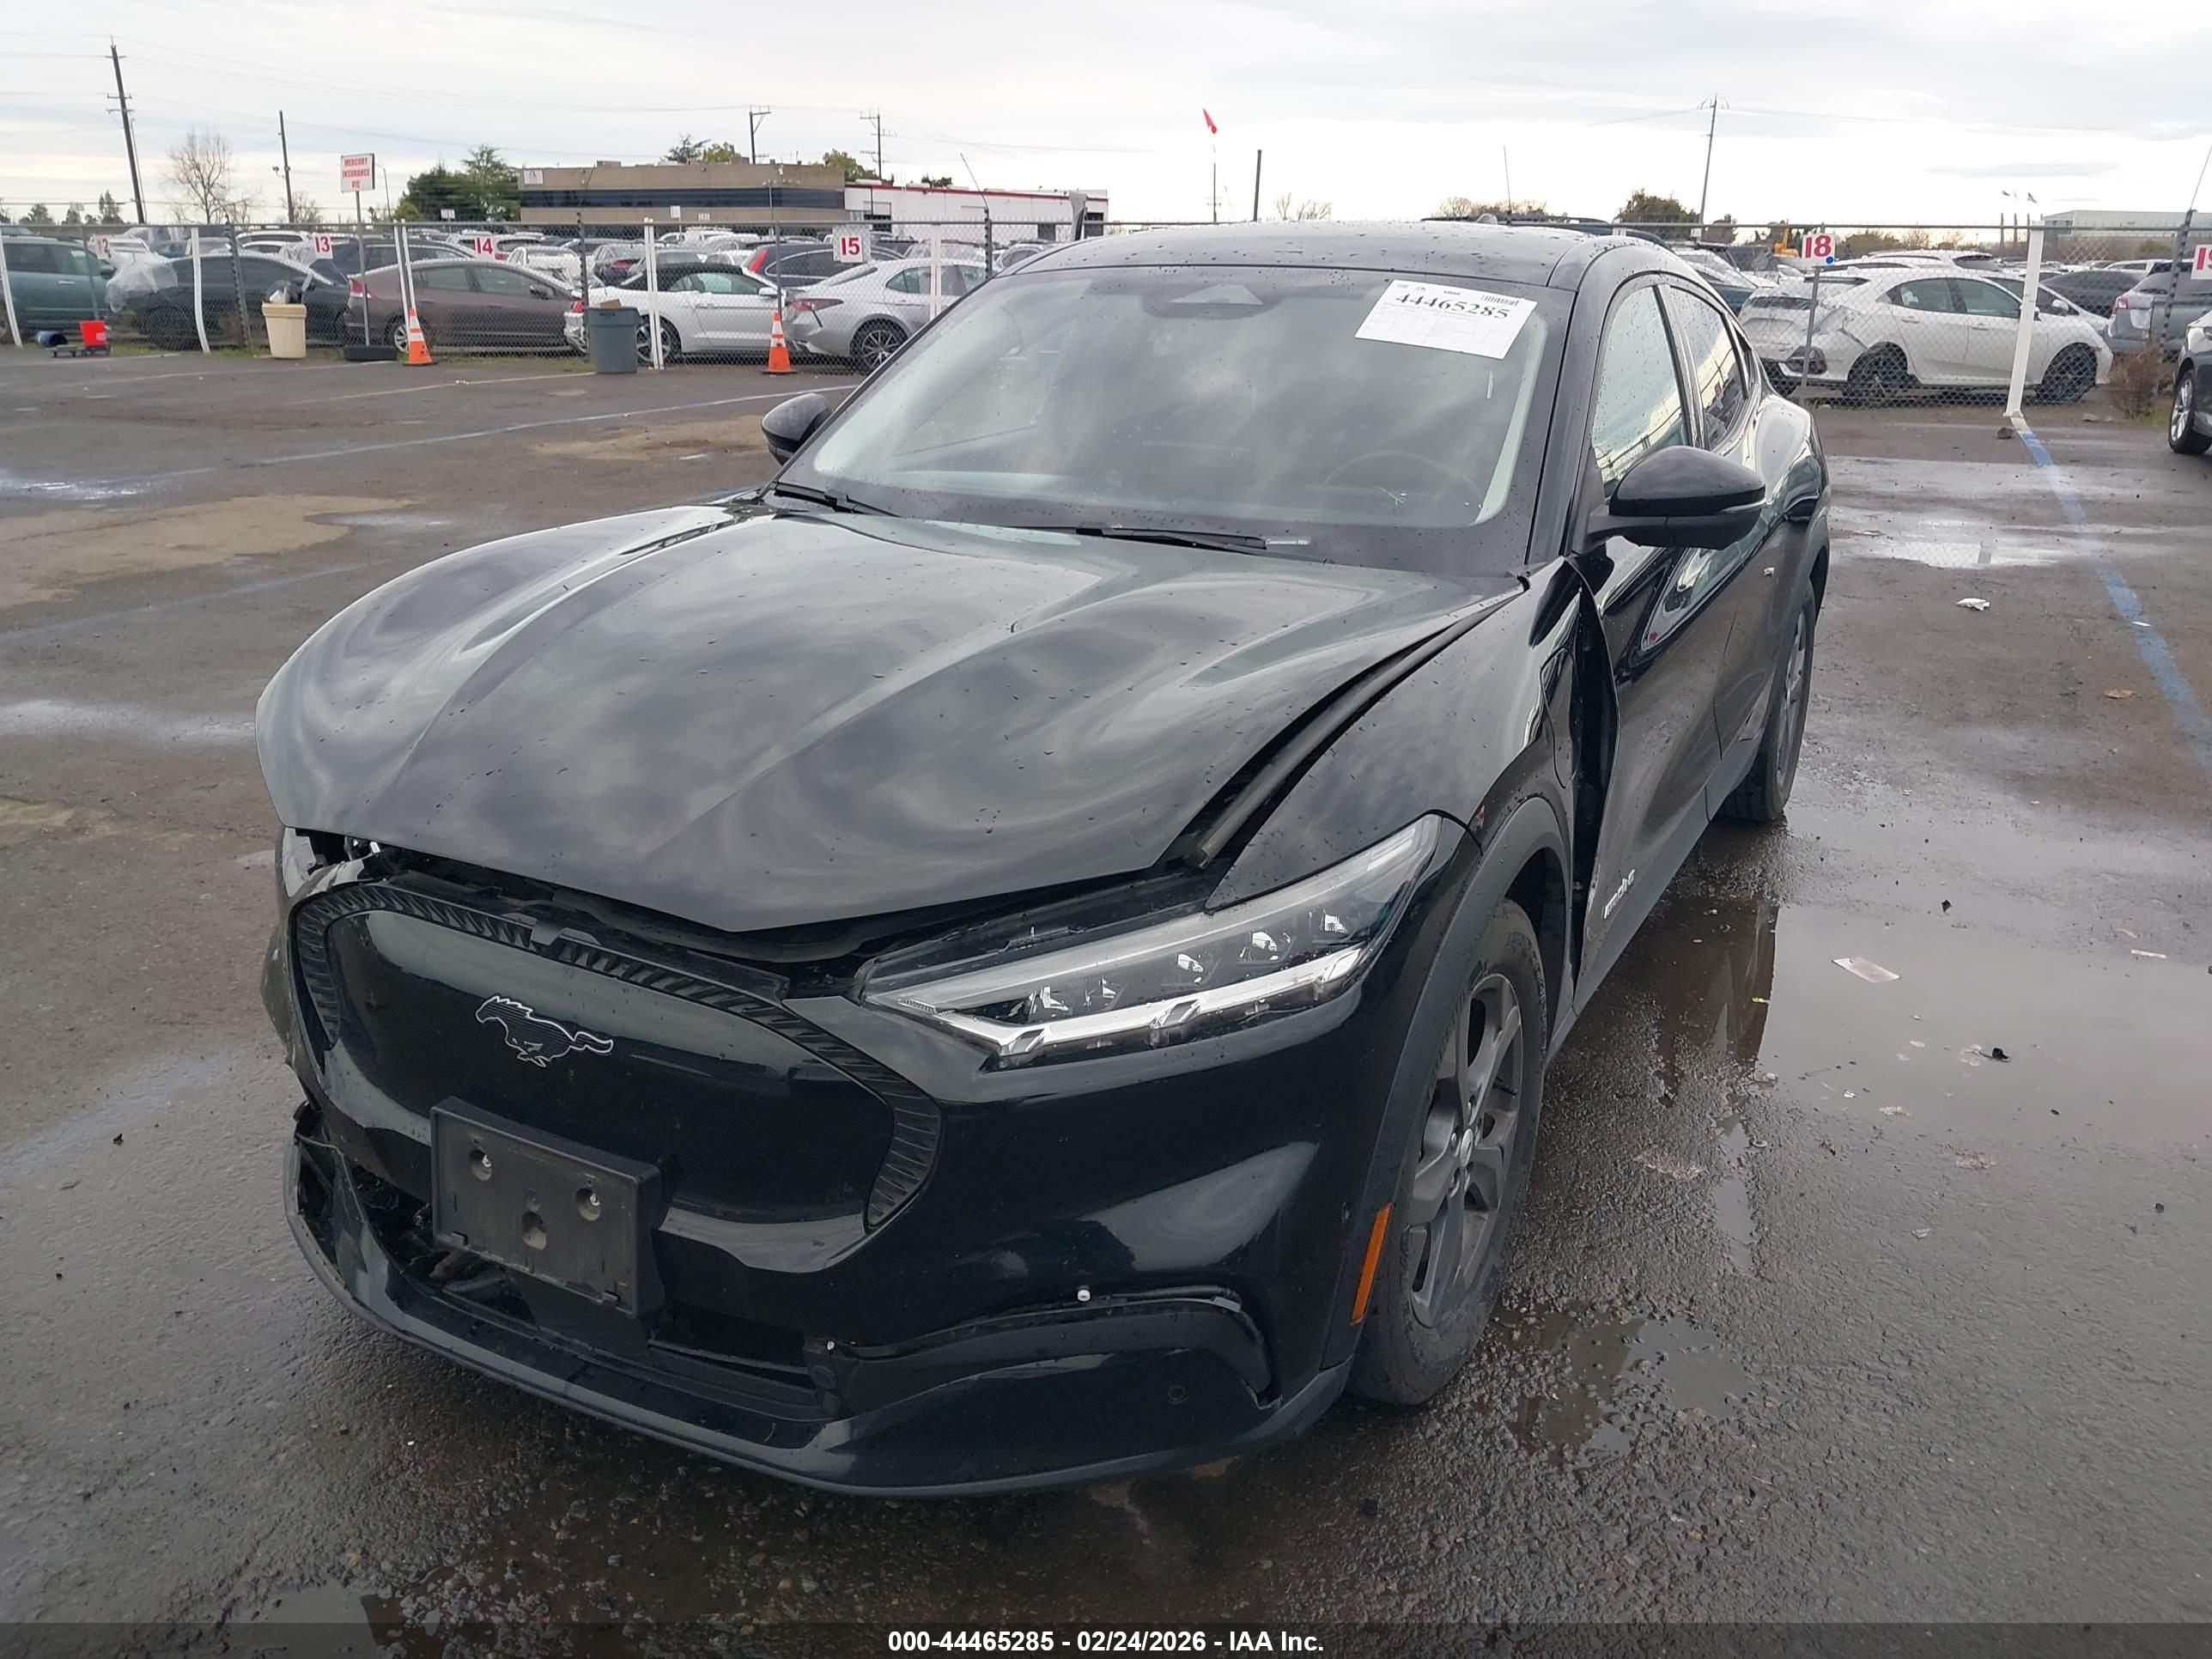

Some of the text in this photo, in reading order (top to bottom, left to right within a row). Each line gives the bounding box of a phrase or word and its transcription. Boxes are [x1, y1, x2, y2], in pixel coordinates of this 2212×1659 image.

[343, 168, 370, 179] INSURANCE
[315, 236, 330, 252] 13
[477, 237, 493, 254] 14
[842, 237, 860, 255] 15
[1805, 234, 1832, 258] 18
[1395, 294, 1510, 319] 44465285
